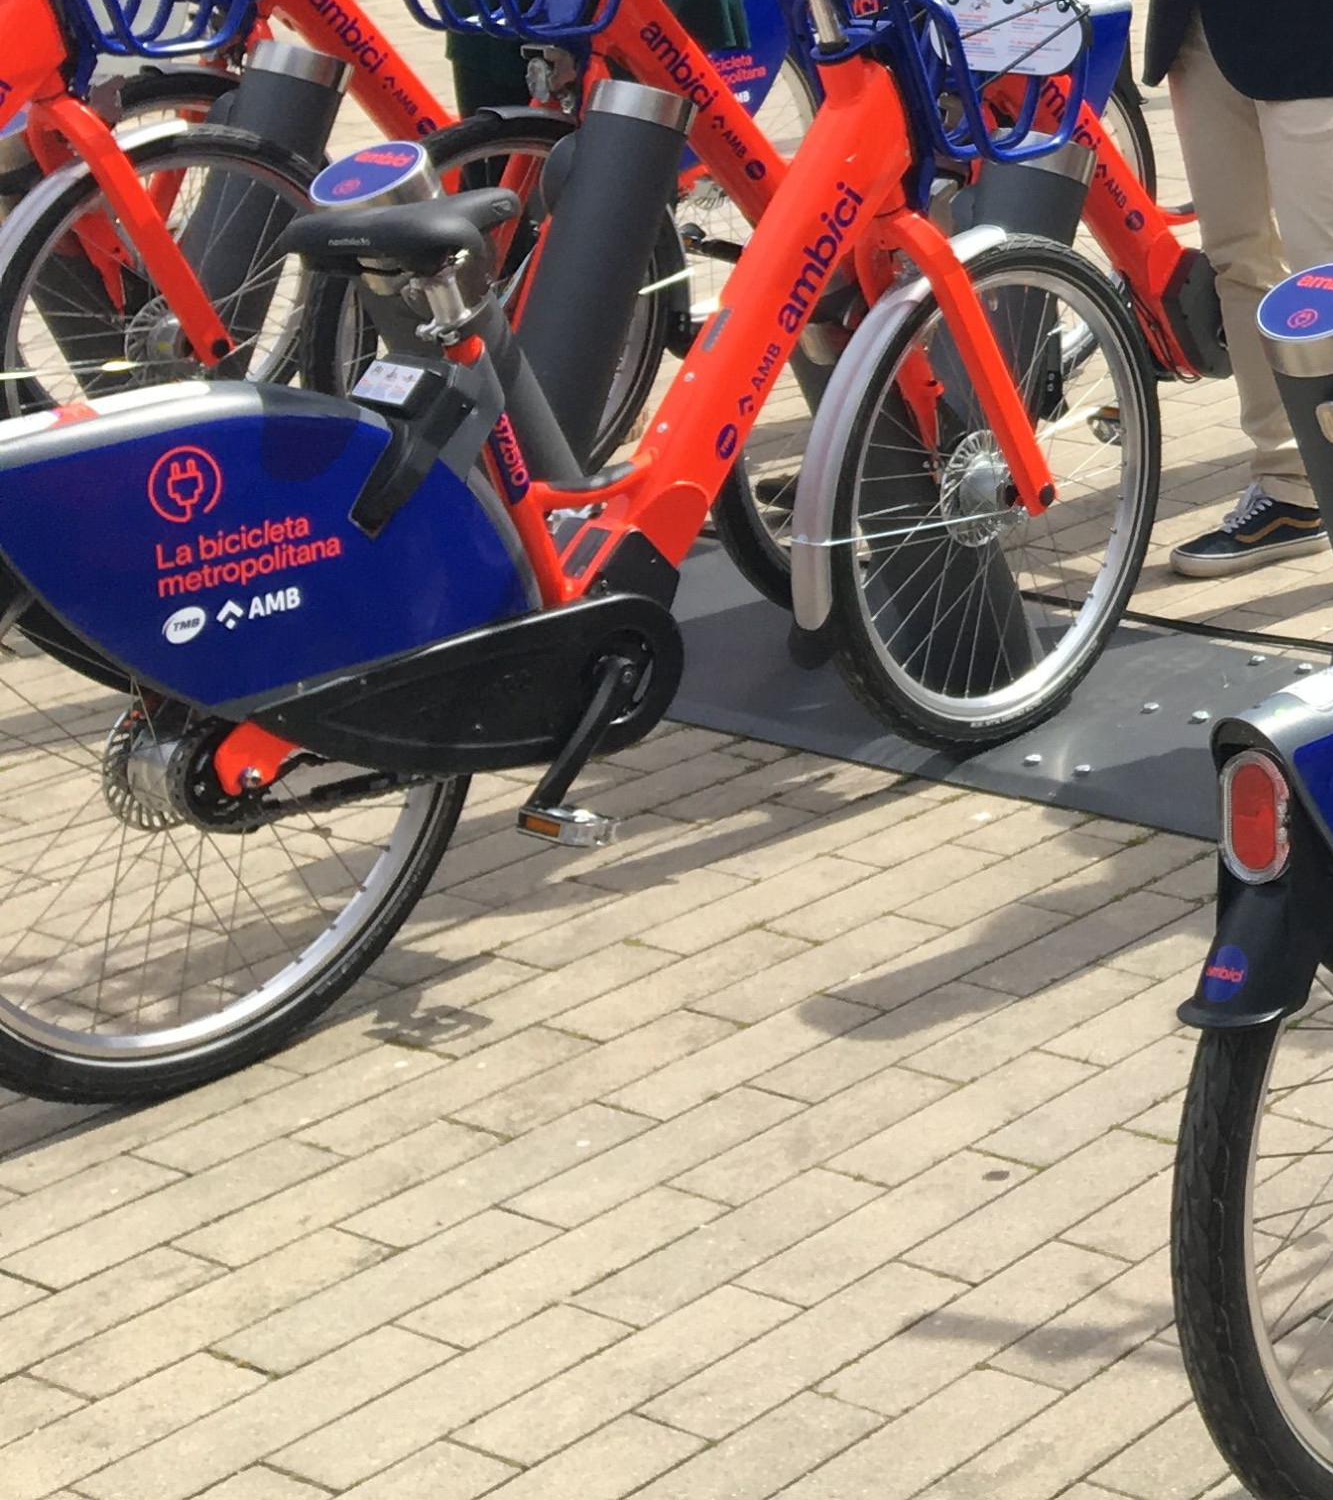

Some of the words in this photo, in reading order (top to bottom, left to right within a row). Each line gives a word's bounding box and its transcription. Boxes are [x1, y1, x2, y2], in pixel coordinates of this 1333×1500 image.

[639, 21, 719, 113] ambici
[722, 130, 747, 159] AMB
[778, 181, 863, 334] ambici
[751, 342, 782, 393] AMB
[156, 544, 193, 569] La
[198, 516, 310, 561] bicicleta
[158, 536, 342, 598] metropolitana
[173, 617, 201, 632] TMB
[249, 587, 301, 620] AMB
